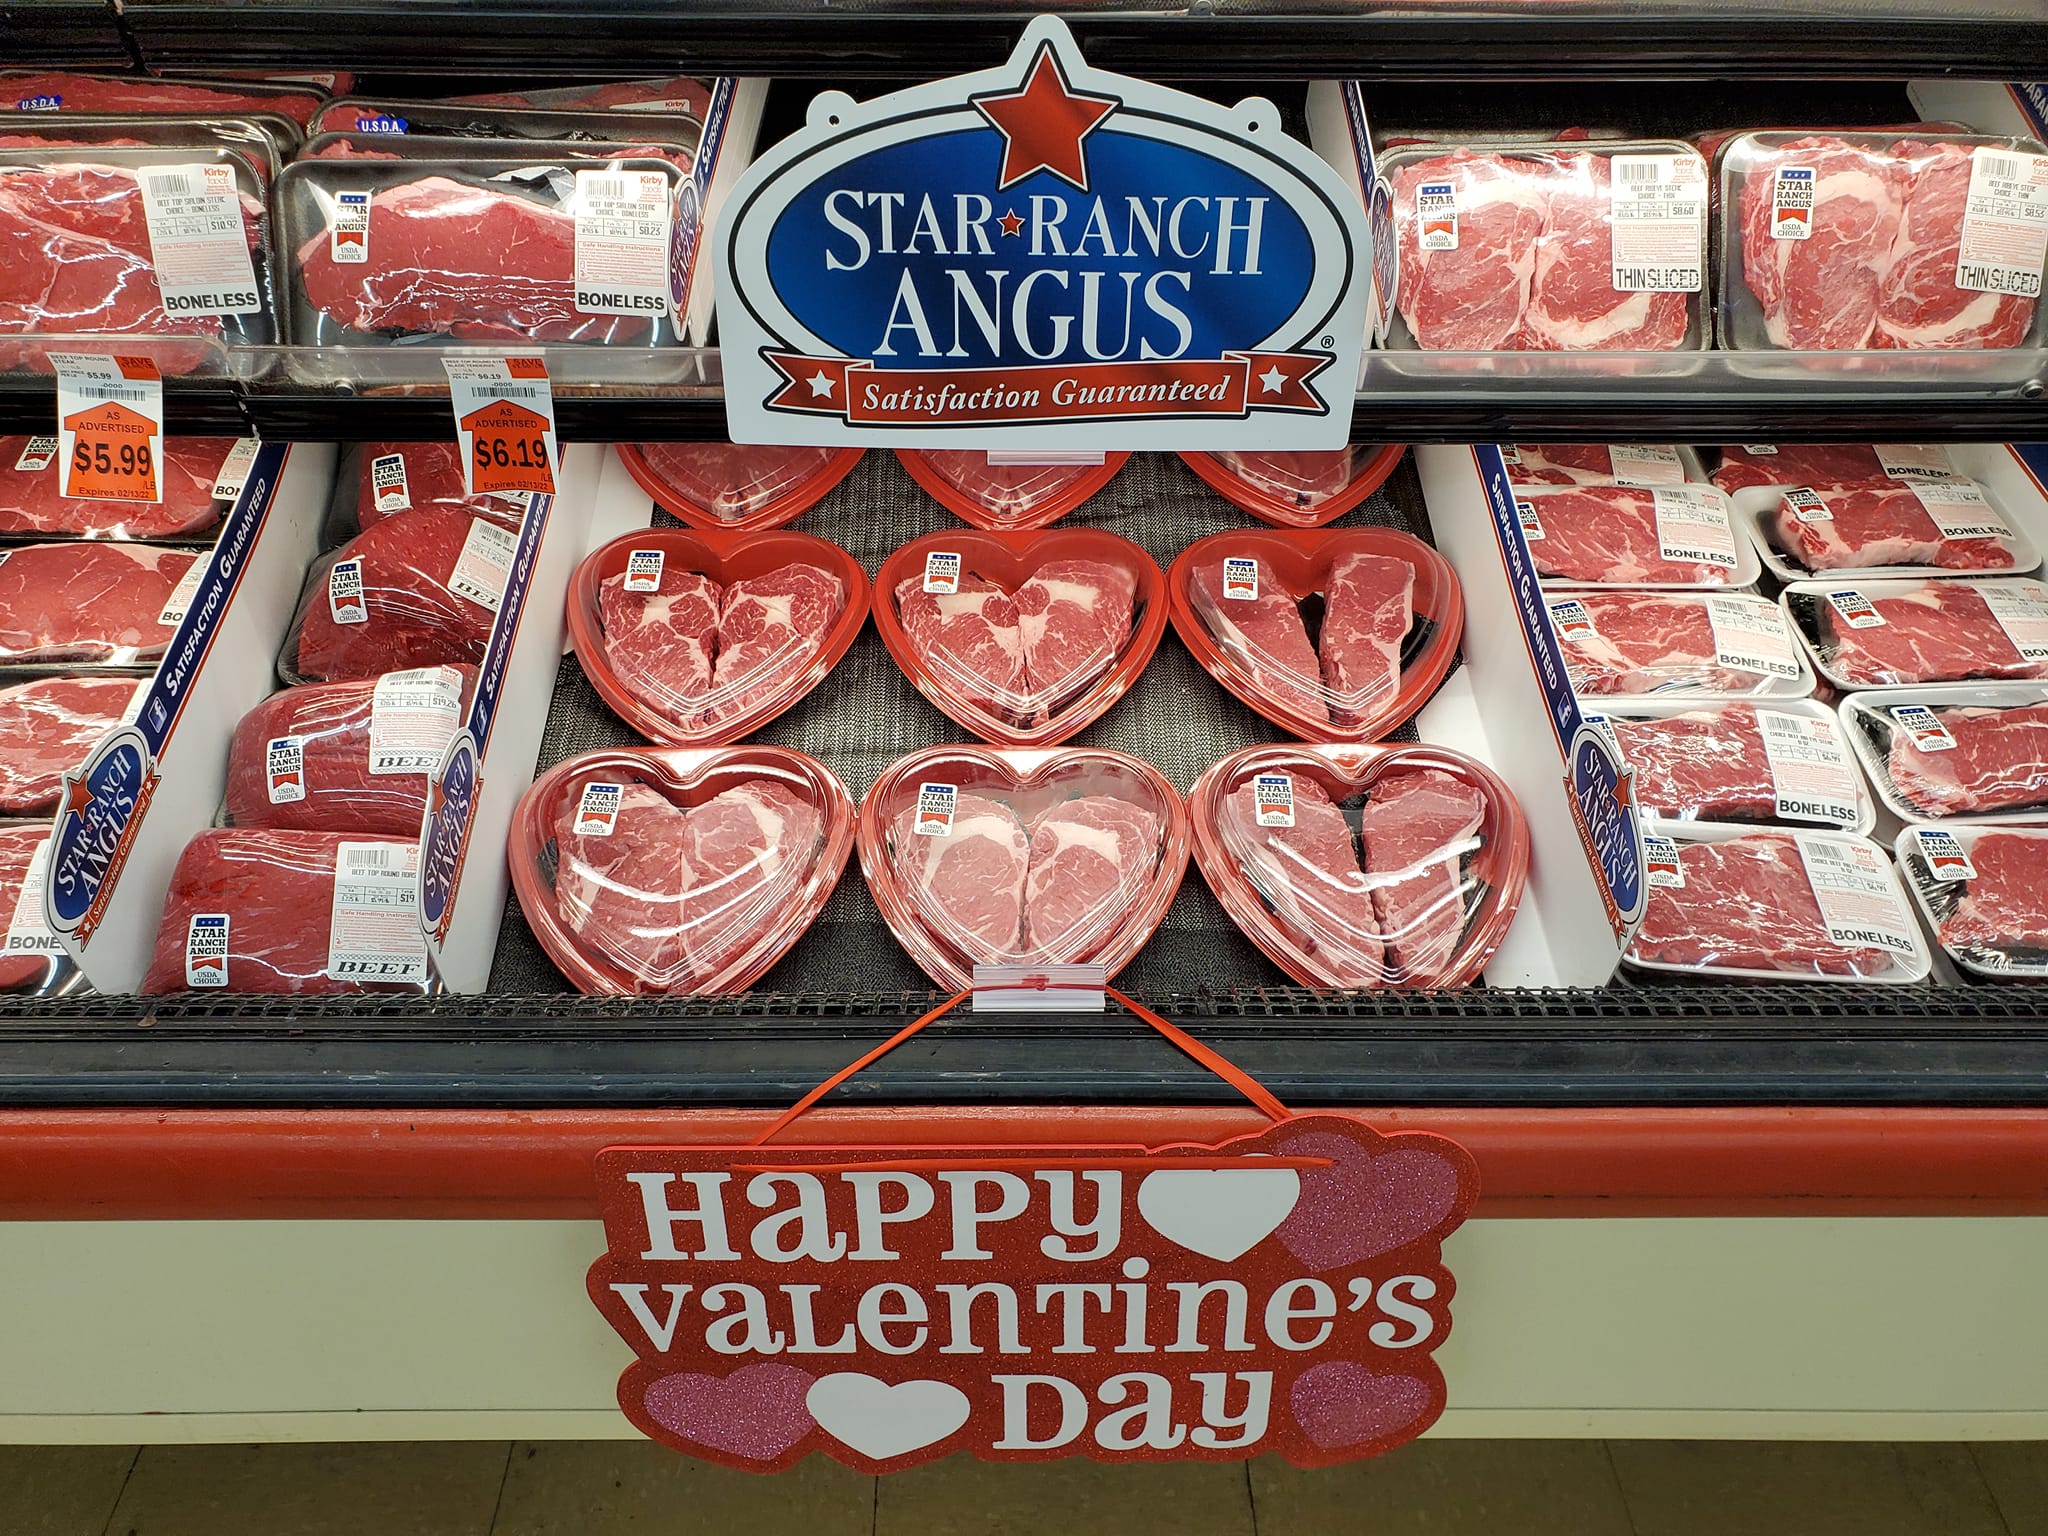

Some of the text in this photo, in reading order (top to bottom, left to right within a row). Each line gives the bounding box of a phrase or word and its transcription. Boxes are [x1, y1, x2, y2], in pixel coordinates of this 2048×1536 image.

[361, 121, 402, 132] U.S.D.A.
[1673, 158, 1696, 167] Kirby
[204, 168, 230, 178] Kirby
[640, 176, 662, 184] Kirby
[1777, 180, 1813, 191] STAR
[1420, 196, 1454, 204] STAR
[1776, 191, 1812, 200] RANCH
[1776, 200, 1811, 208] ANGUS
[823, 188, 1263, 286] STAR RANCH
[1426, 240, 1452, 248] CHOICE
[1616, 268, 1699, 288] THIN SLICED
[1960, 266, 2039, 294] THIN SLICED
[166, 292, 258, 310] BONELESS
[578, 292, 664, 309] BONELESS
[871, 267, 1193, 361] ANGUS
[86, 372, 112, 380] $5.99
[861, 374, 1231, 413] Satisfaction Guaranteed
[106, 412, 121, 420] AS
[500, 408, 512, 416] AS
[78, 421, 144, 434] ADVERTISED
[475, 419, 538, 428] ADVERTISED
[74, 439, 150, 476] $5.99
[474, 436, 546, 471] $6.19
[374, 464, 402, 476] STAR
[375, 471, 404, 482] RANCH
[376, 478, 406, 488] ANGUS
[484, 480, 548, 490] Expires 02/13/22
[78, 486, 149, 498] Expires 02/13/22
[1943, 526, 2012, 537] BONELESS
[1664, 547, 1736, 566] BONELESS
[332, 572, 359, 583] STAR
[1492, 472, 1524, 584] SATISFACTION
[1520, 574, 1558, 690] GUARANTEED
[166, 582, 224, 698] SATISFACTION
[219, 477, 266, 580] GUARANTEED
[332, 582, 360, 591] RANCH
[1832, 595, 1864, 604] STAR
[1837, 600, 1868, 609] RANCH
[1552, 608, 1580, 617] STAR
[1841, 606, 1872, 614] ANGUS
[339, 614, 362, 622] CHOICE
[1554, 613, 1584, 621] RANCH
[486, 583, 520, 700] SATISFACTION
[1720, 654, 1797, 676] BONELESS
[1898, 714, 1934, 722] STAR
[1903, 719, 1938, 727] RANCH
[1908, 724, 1942, 732] ANGUS
[270, 748, 300, 760] STAR
[270, 757, 300, 768] RANCH
[270, 765, 300, 775] ANGUS
[1257, 784, 1290, 793] STAR
[275, 793, 300, 802] CHOICE
[585, 792, 619, 802] STAR
[921, 793, 954, 802] STAR
[583, 800, 618, 808] RANCH
[920, 800, 954, 808] RANCH
[582, 806, 616, 814] ANGUS
[1780, 800, 1856, 822] BONELESS
[58, 748, 132, 896] STAR RANCH
[1584, 748, 1609, 805] STAR
[1606, 804, 1638, 890] RANCH
[1577, 786, 1617, 888] ANGUS
[1920, 838, 1957, 846] STAR
[79, 788, 134, 901] ANGUS
[1923, 844, 1962, 852] RANCH
[1927, 850, 1964, 858] ANGUS
[1590, 848, 1614, 911] Guaranteed
[192, 928, 226, 938] STAR
[190, 938, 226, 947] RANCH
[1832, 928, 1912, 953] BONELESS
[190, 948, 226, 956] ANGUS
[336, 962, 421, 974] BEEF
